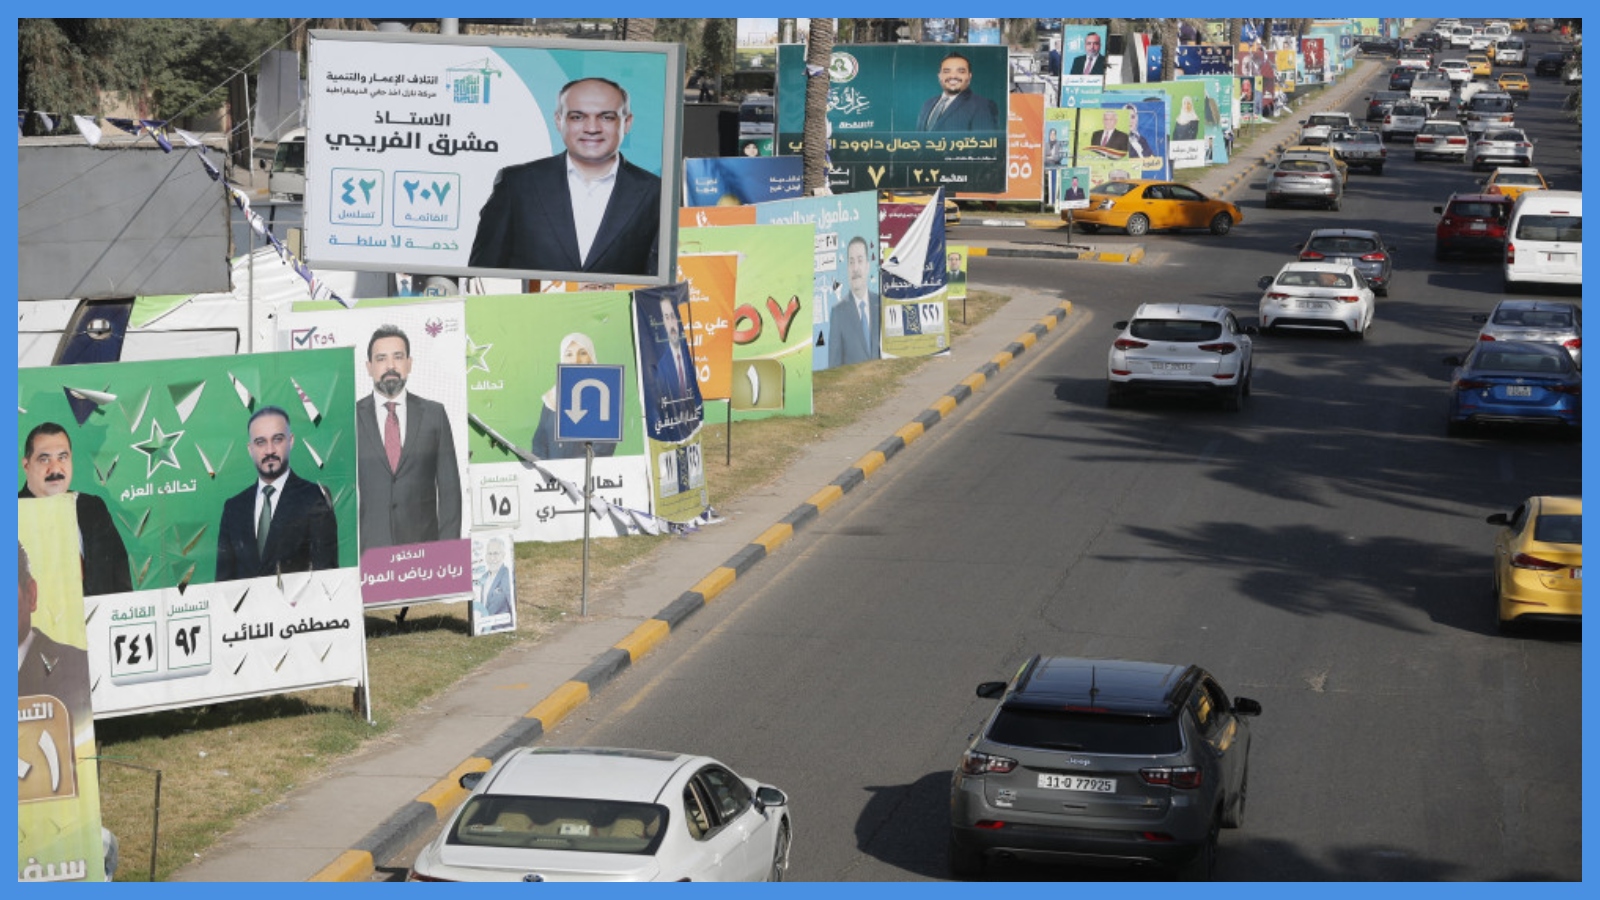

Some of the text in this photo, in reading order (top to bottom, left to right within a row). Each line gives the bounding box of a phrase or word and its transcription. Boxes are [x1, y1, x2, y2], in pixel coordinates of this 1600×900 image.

[325, 131, 499, 156] مشرق الفريجي
[838, 138, 884, 152] داوود
[886, 138, 921, 153] جمال
[925, 137, 947, 152] زيد
[949, 137, 998, 152] الدكتور
[341, 176, 377, 206] ٤٢
[402, 179, 452, 207] ٢٠٧
[390, 234, 402, 248] لا
[120, 478, 198, 502] تحالف العزم
[489, 493, 512, 518] ١٥
[389, 548, 425, 564] الدكتور
[398, 566, 433, 584] رياض
[436, 563, 464, 579] ريان
[111, 605, 157, 622] القائمة
[221, 616, 351, 649] مصطفى النائب
[113, 632, 155, 666] ٢٤١
[174, 625, 202, 658] ٩٢
[1076, 778, 1113, 792] 77925
